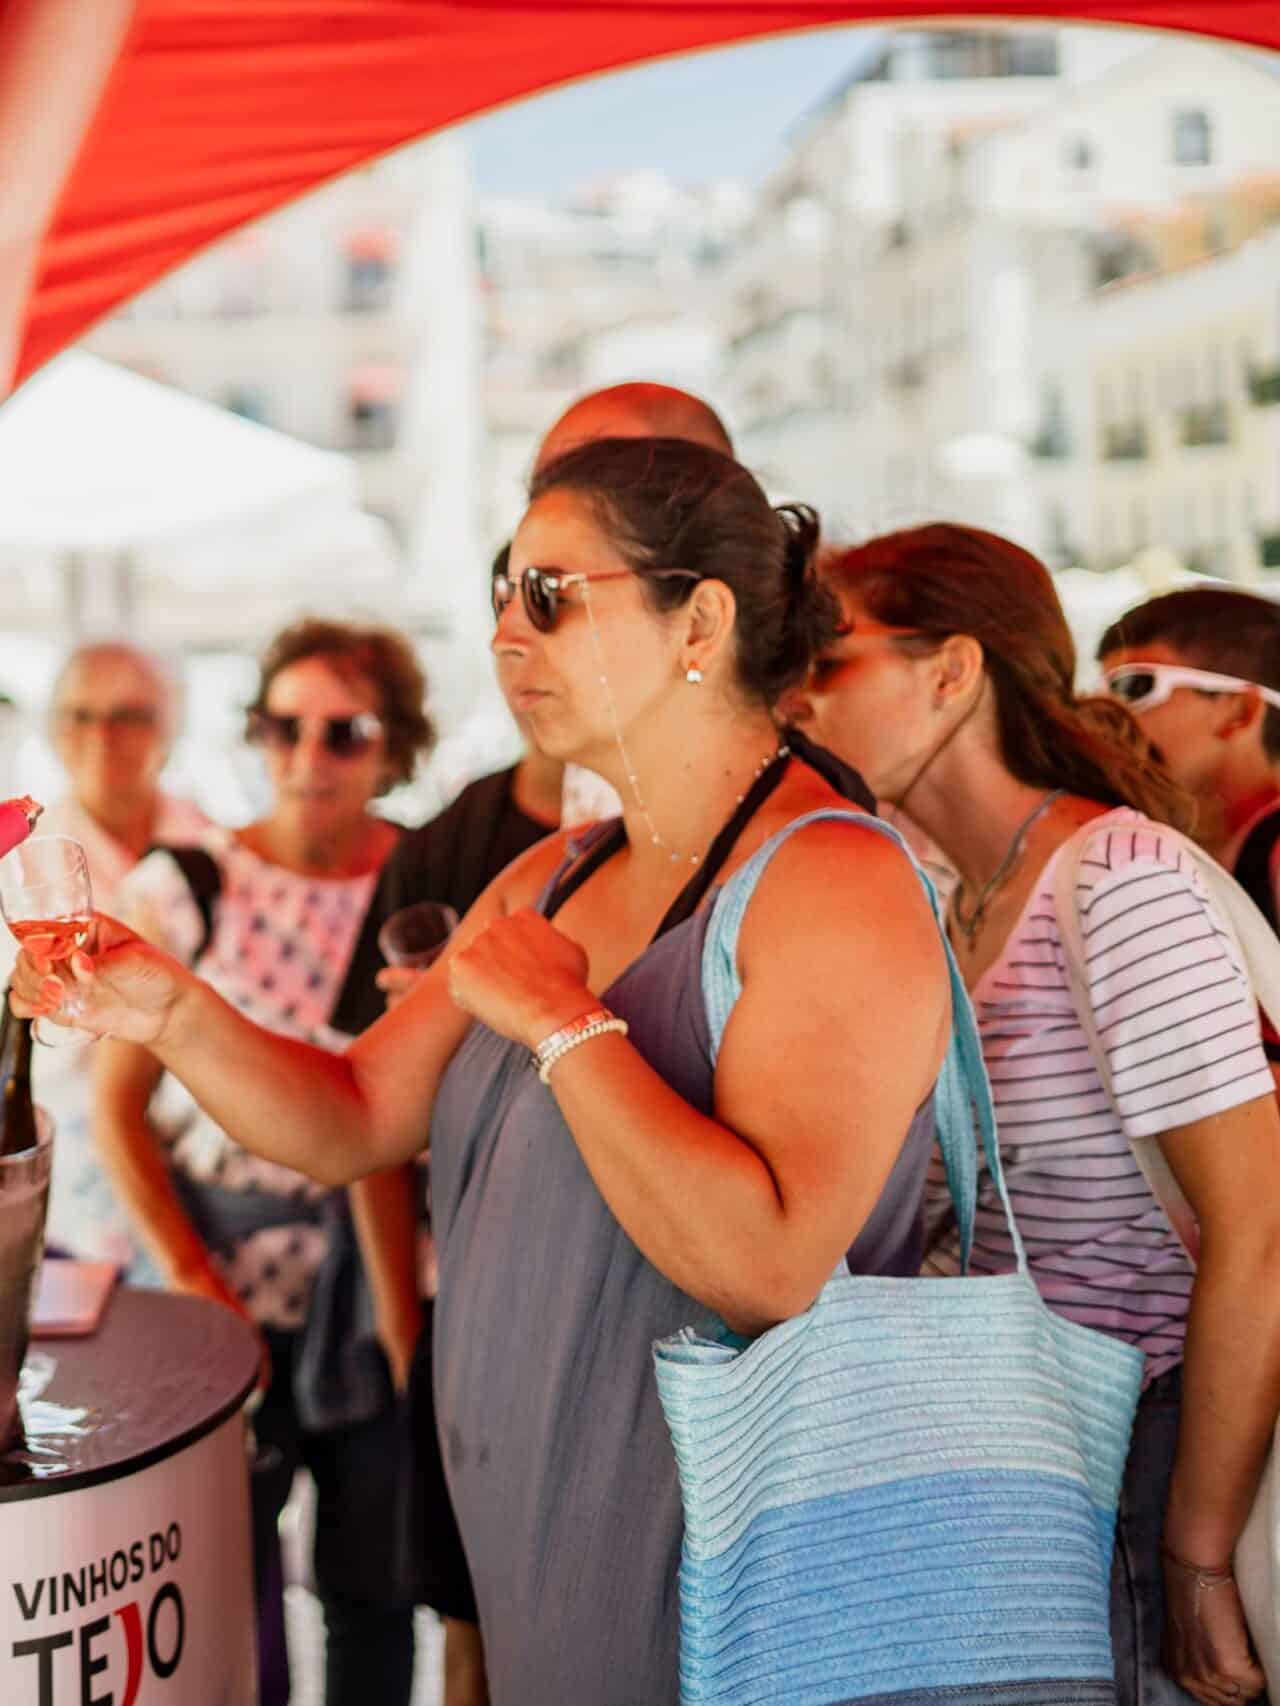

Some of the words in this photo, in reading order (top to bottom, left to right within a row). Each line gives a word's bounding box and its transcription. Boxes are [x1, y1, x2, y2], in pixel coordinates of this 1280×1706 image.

[12, 1541, 144, 1620] VINHOS
[149, 1522, 182, 1573] DO
[12, 1581, 186, 1706] TEJO
